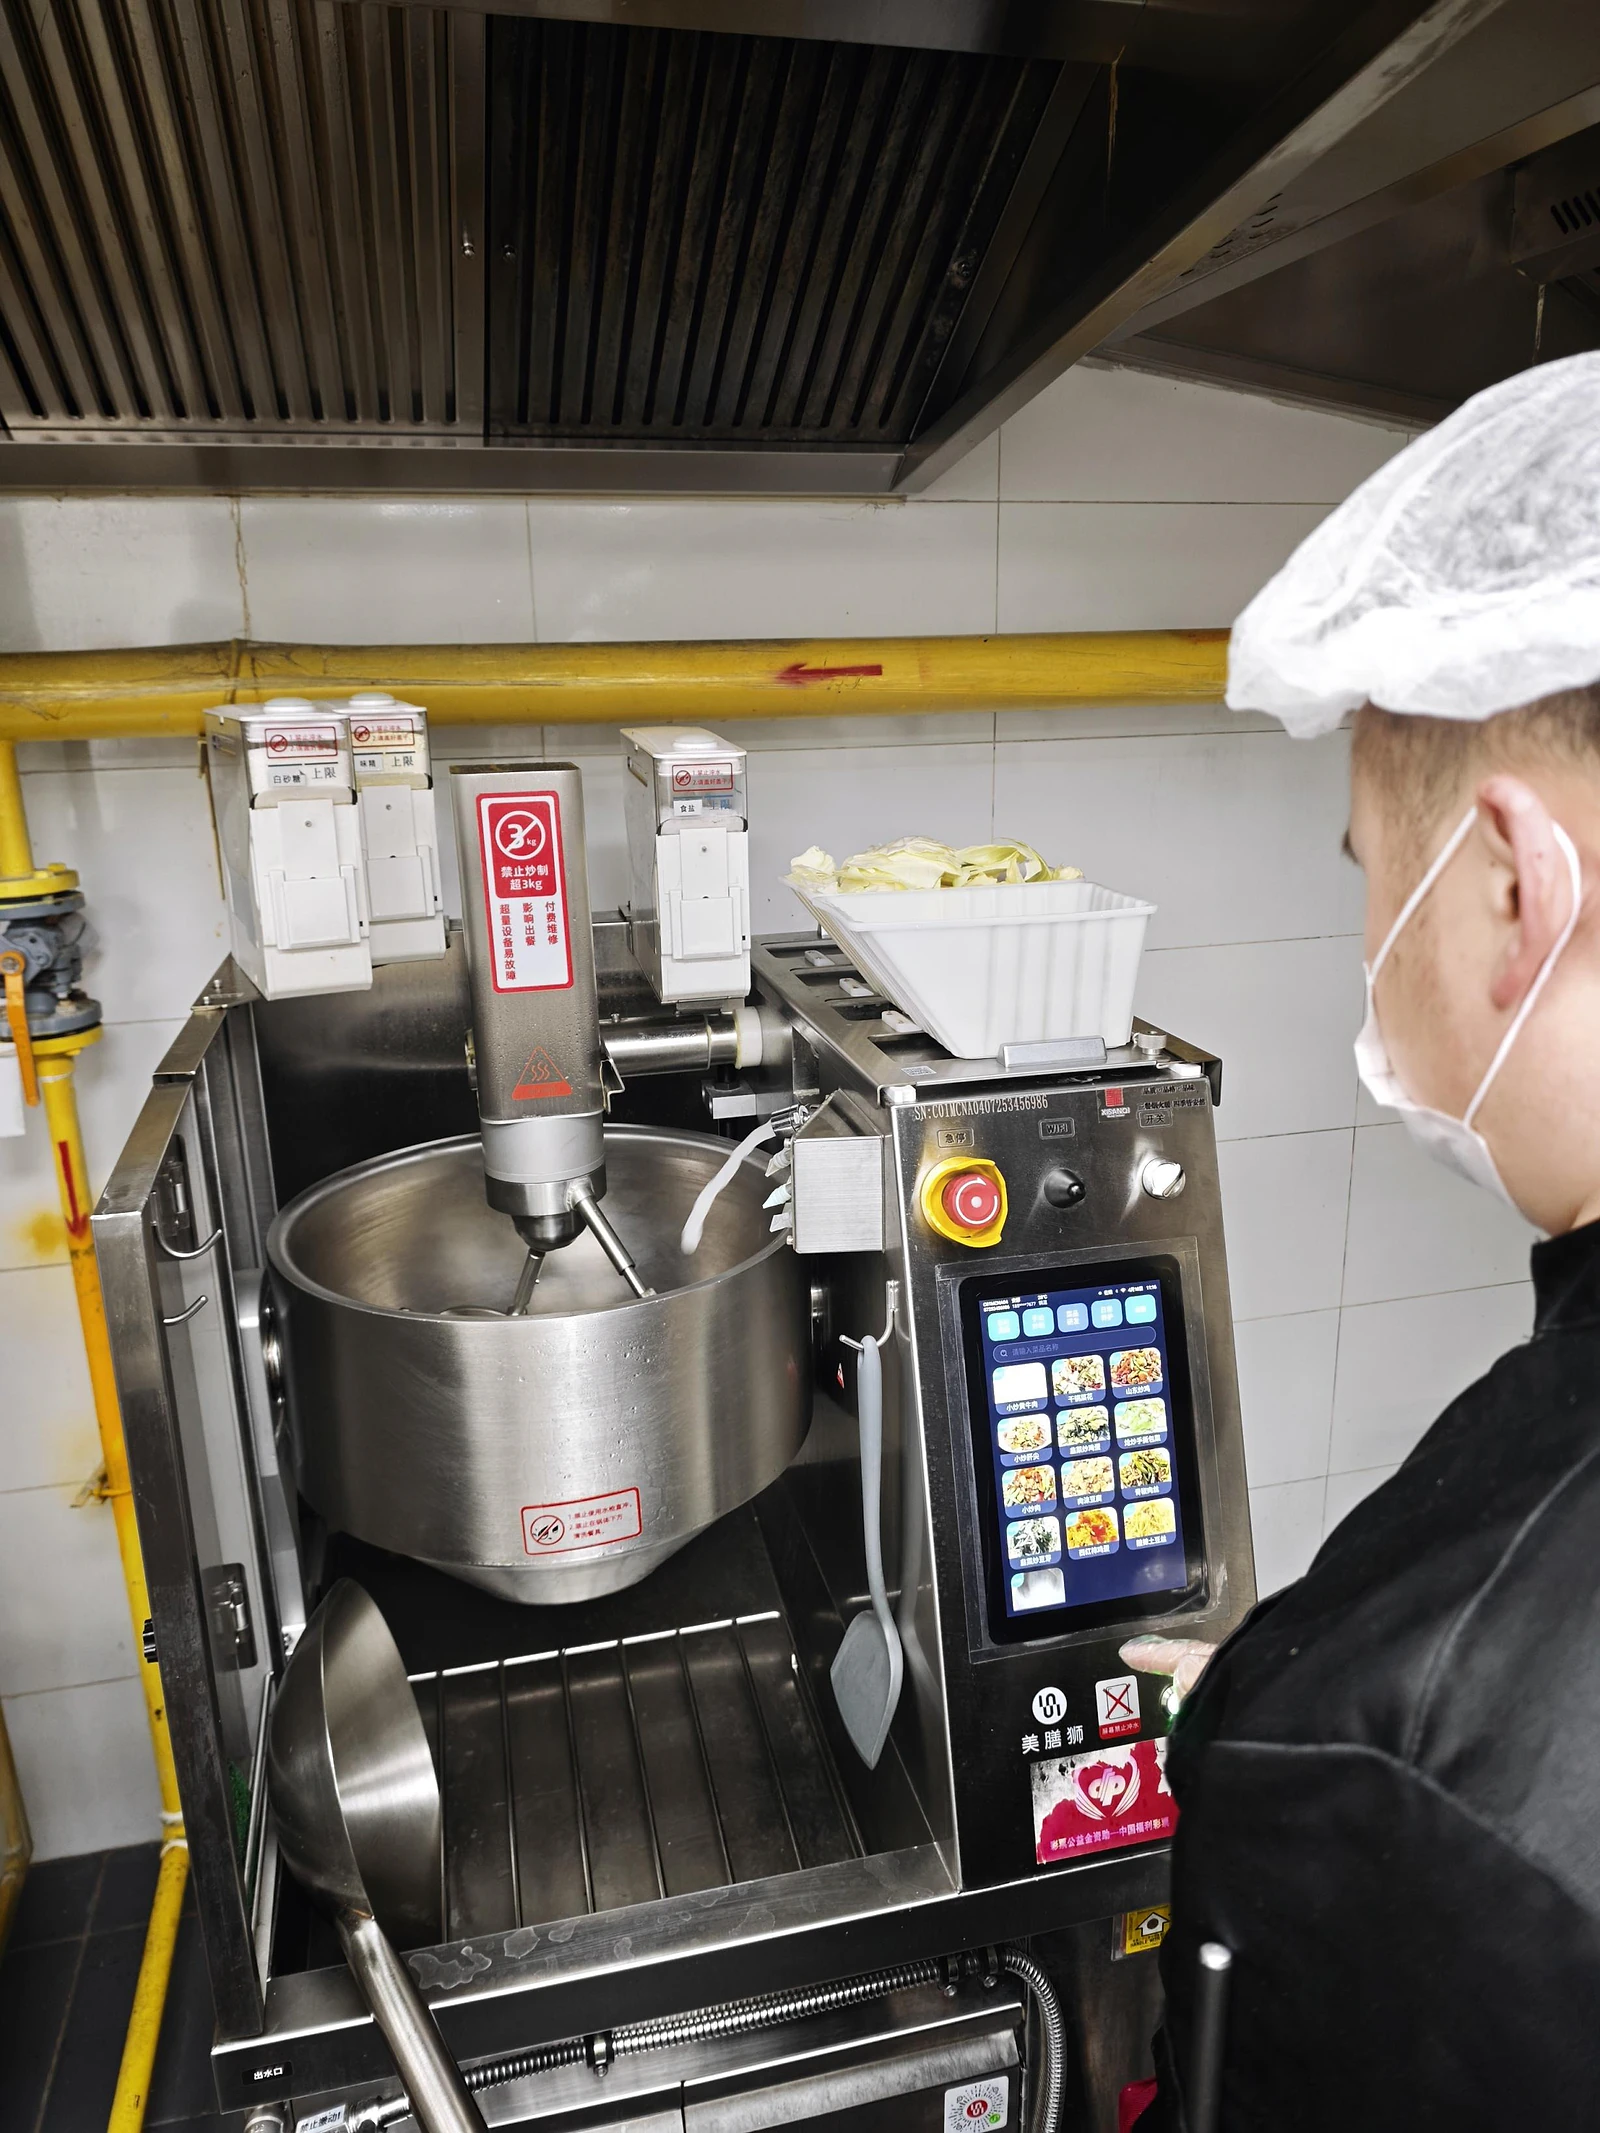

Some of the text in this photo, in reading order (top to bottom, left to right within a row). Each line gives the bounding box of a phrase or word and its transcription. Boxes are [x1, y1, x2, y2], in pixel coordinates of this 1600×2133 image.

[391, 755, 414, 768] 上限
[273, 774, 301, 784] 白砂糖
[312, 766, 337, 780] 上限
[680, 804, 695, 813] 食盐
[526, 838, 537, 847] kg
[501, 864, 549, 878] 禁止炒制
[510, 879, 543, 891] 超3kg
[522, 902, 536, 947] 影响出餐
[545, 901, 559, 945] 付费维修
[500, 903, 516, 981] 超量设备易故障
[1146, 1114, 1164, 1125] 开关
[1046, 1123, 1069, 1134] WIFI
[945, 1132, 967, 1144] 急停
[1006, 1400, 1039, 1412] 小炒黄牛肉
[1021, 1504, 1042, 1515] 小炒肉
[1102, 1722, 1140, 1736] 屏幕禁止冲水
[1021, 1724, 1085, 1755] 美膳狮
[253, 2066, 284, 2081] 出水口
